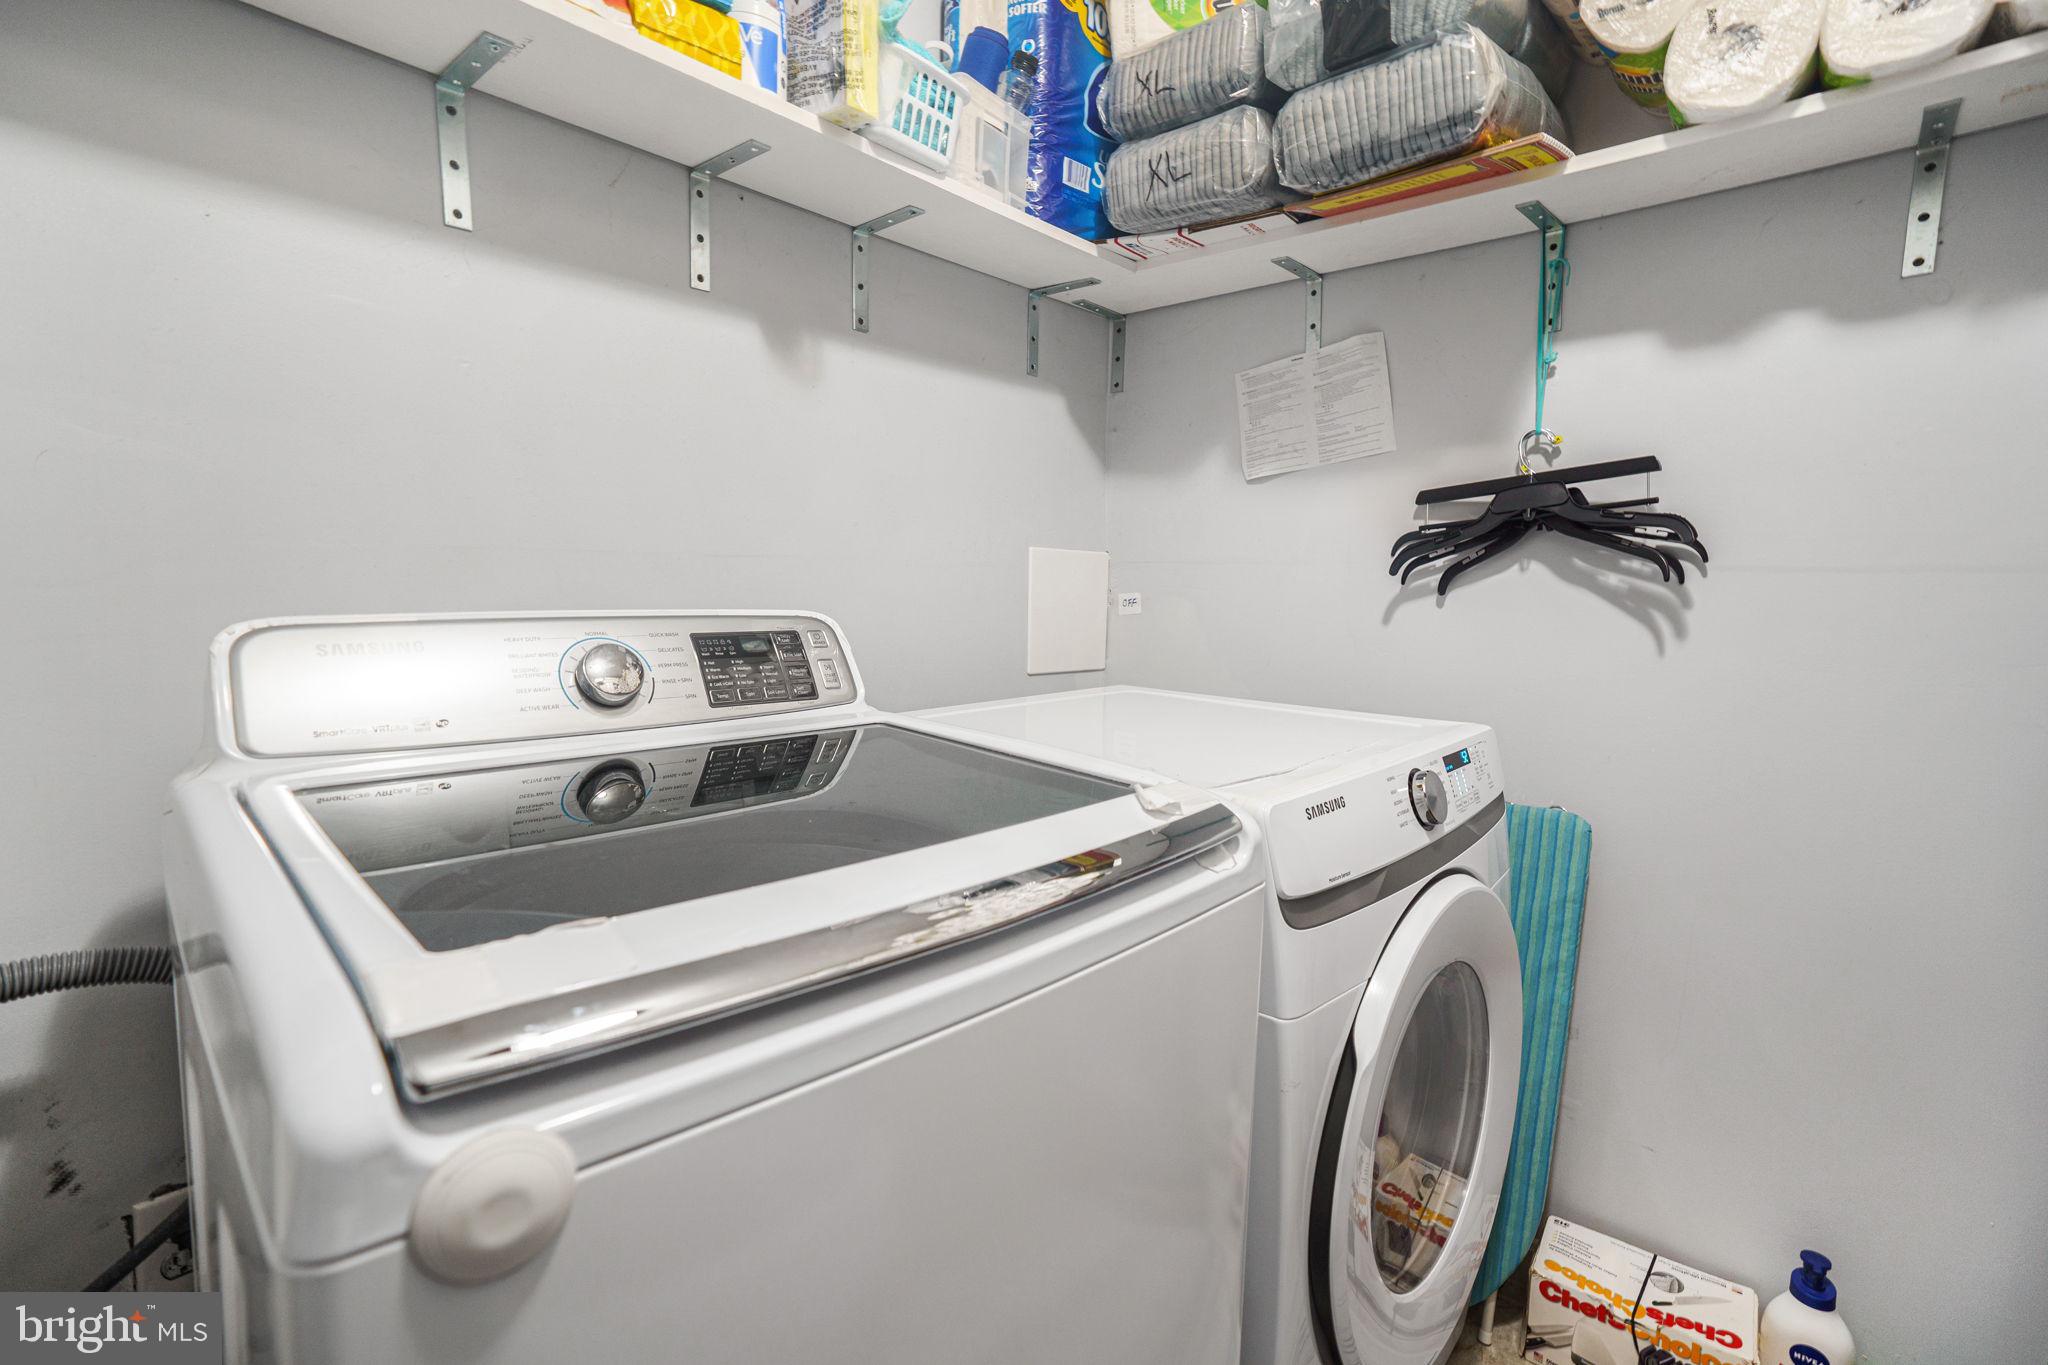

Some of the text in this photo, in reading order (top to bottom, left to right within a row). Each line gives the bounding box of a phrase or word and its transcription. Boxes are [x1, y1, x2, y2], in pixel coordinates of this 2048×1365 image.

[1008, 3, 1047, 17] SOFTER
[1136, 69, 1176, 102] XL
[1146, 151, 1192, 201] XL
[1305, 795, 1346, 821] SAMSUNG
[1544, 1259, 1646, 1319] Choice
